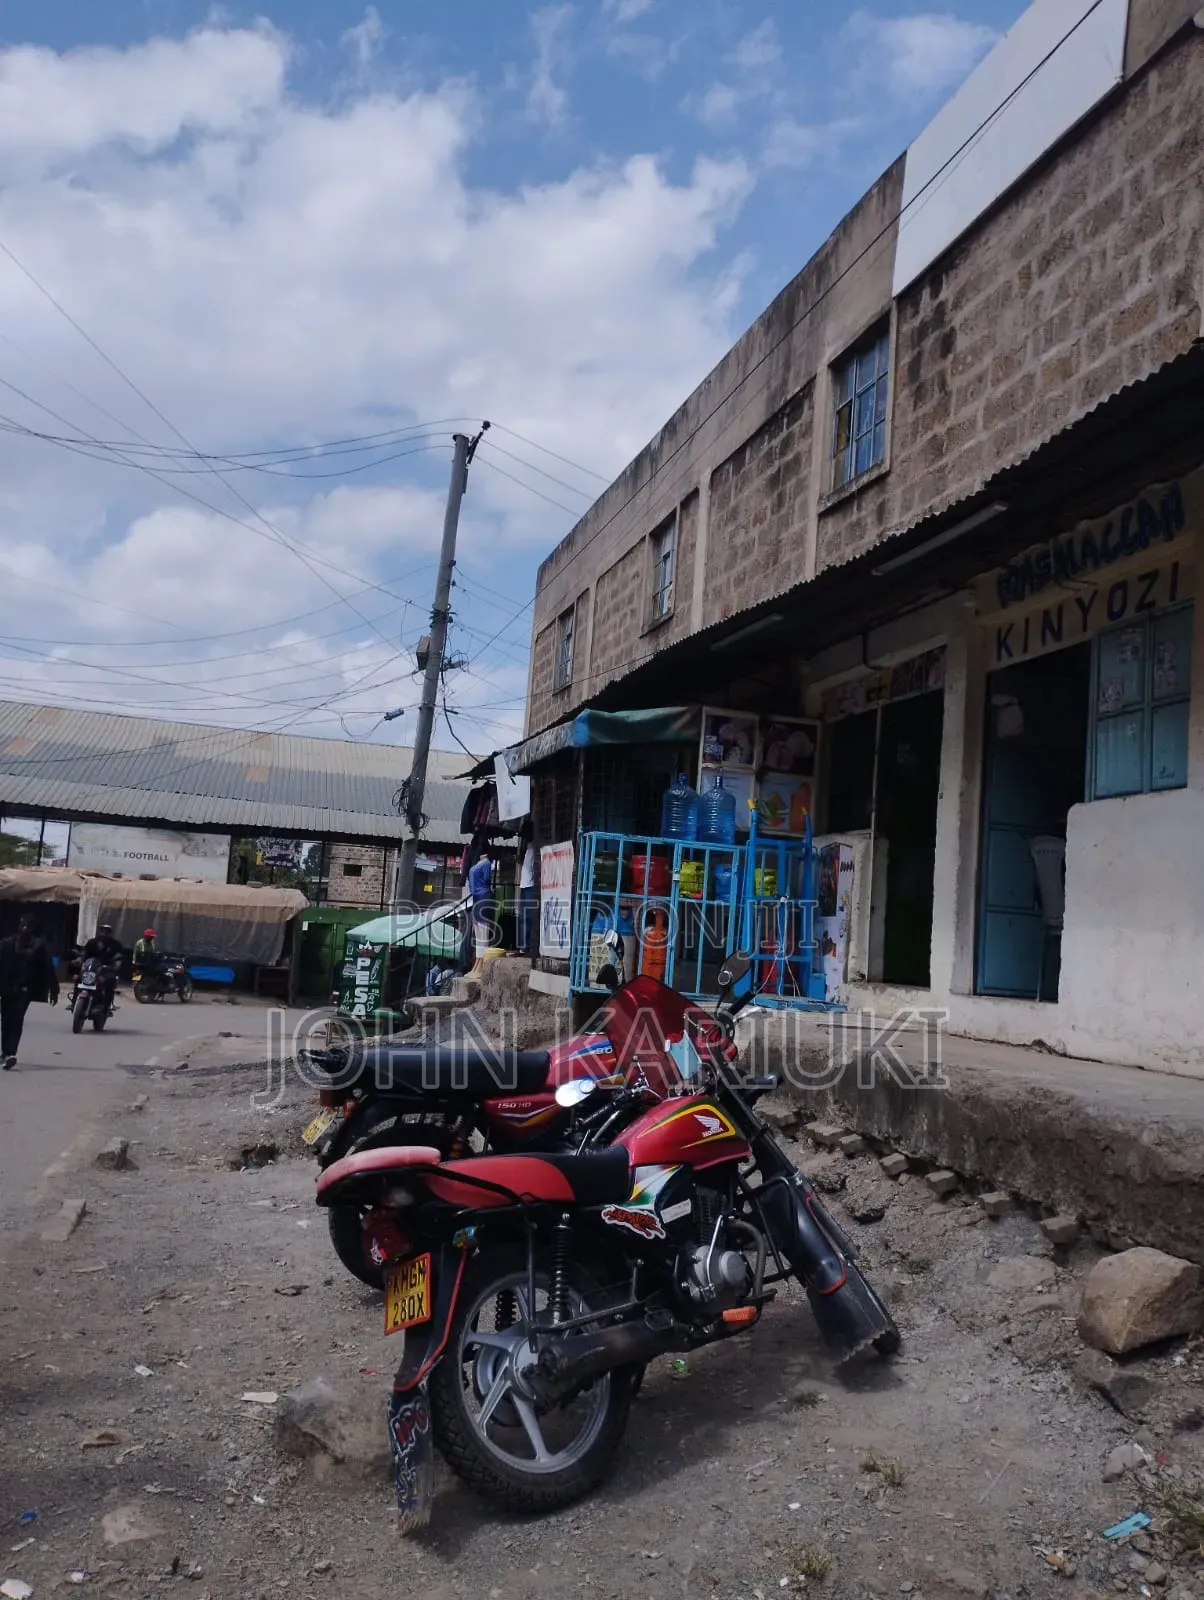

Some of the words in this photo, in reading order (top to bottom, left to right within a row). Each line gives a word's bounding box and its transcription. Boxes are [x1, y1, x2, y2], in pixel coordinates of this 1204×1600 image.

[996, 561, 1179, 662] KINYOZI
[123, 851, 169, 862] FOOTBALL
[351, 957, 370, 1019] PESA
[702, 1127, 724, 1138] HONDA
[393, 1291, 425, 1326] 280X
